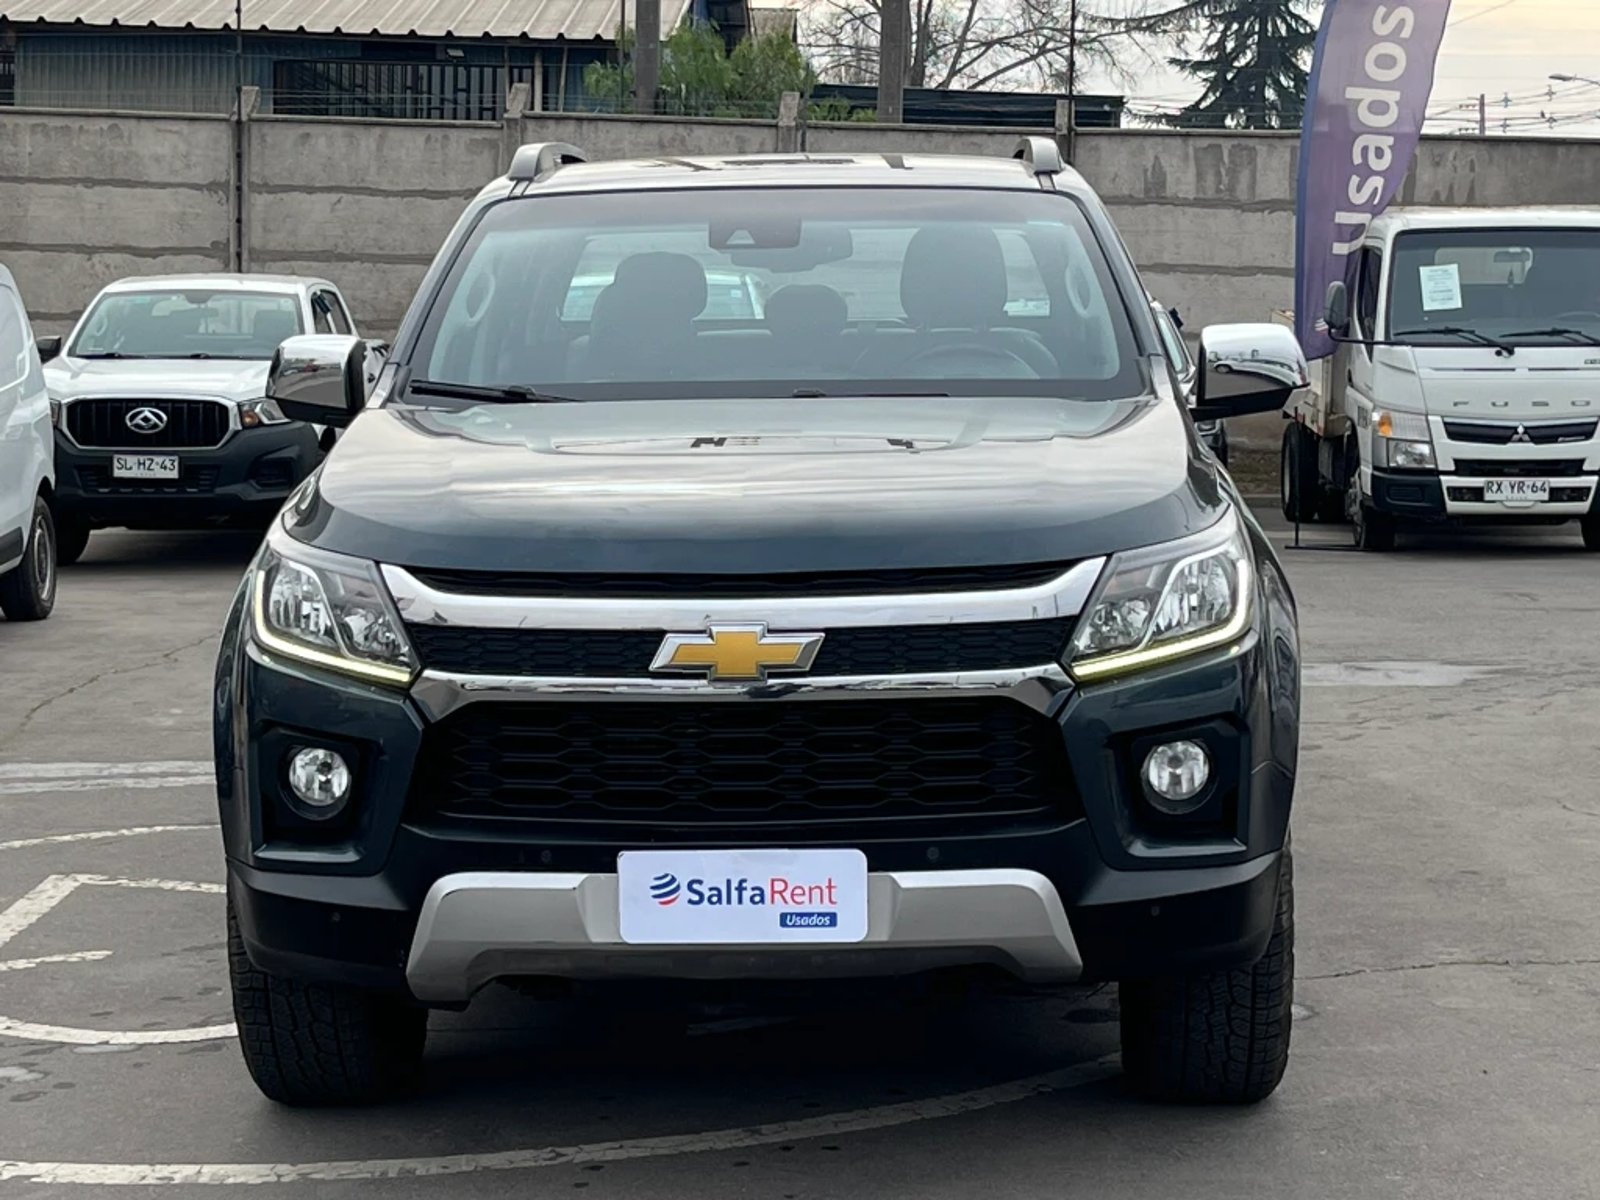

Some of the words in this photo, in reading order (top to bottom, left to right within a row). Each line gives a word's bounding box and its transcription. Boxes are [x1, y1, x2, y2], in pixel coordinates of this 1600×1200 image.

[1332, 4, 1415, 256] Usados
[686, 877, 838, 906] SalfaRent
[785, 914, 831, 926] Usados
